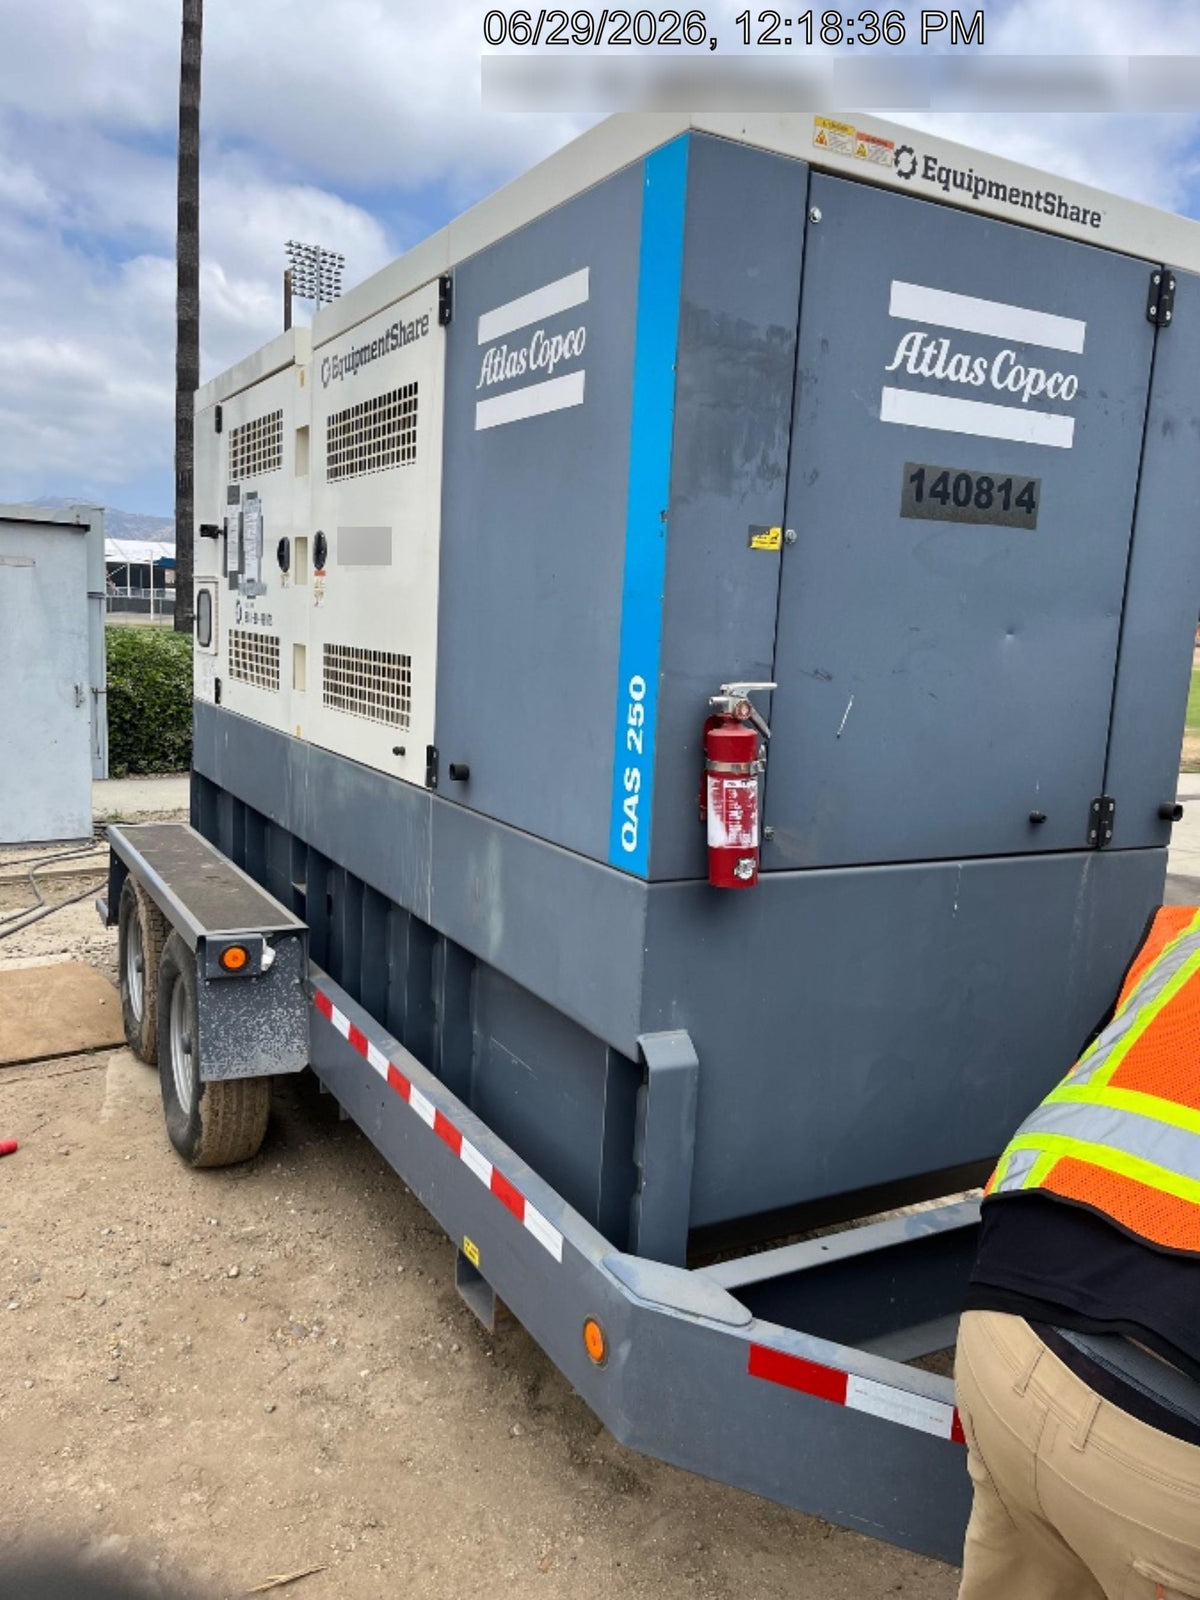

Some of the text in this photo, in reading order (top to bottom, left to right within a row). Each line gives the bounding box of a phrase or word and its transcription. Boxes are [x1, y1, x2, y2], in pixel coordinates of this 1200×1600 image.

[921, 154, 1102, 229] EquipmentShare
[331, 313, 430, 382] EquipmentShare
[909, 467, 1037, 515] 140814
[621, 674, 647, 853] QAS 250
